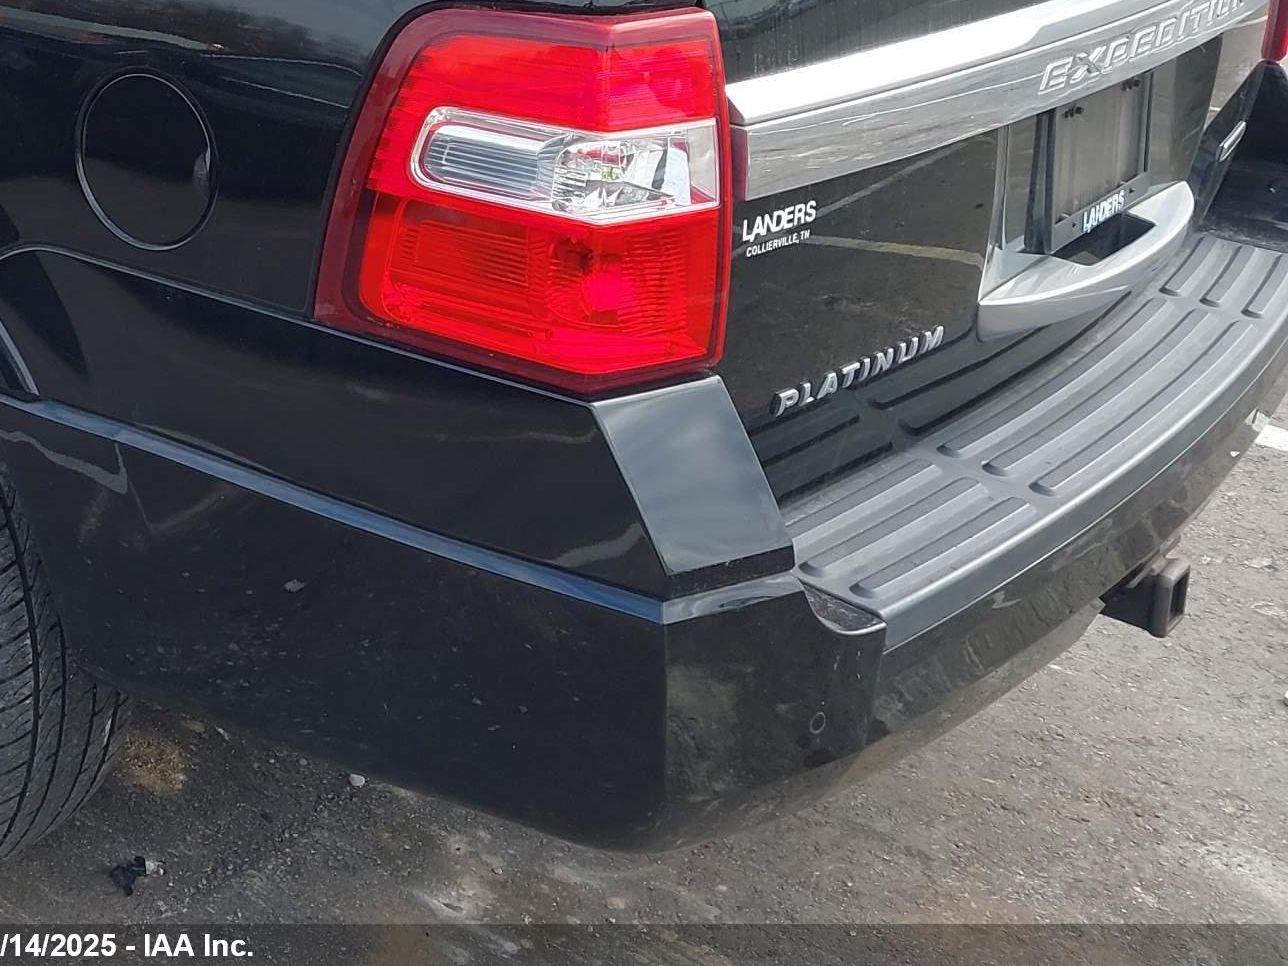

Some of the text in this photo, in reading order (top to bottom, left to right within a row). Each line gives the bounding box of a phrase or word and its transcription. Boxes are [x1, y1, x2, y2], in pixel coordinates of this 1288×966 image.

[742, 200, 817, 243] LANDERS
[1083, 189, 1125, 234] LANDERS
[746, 229, 811, 258] COLLIERVILLE, TN
[771, 324, 945, 418] PLATINUM
